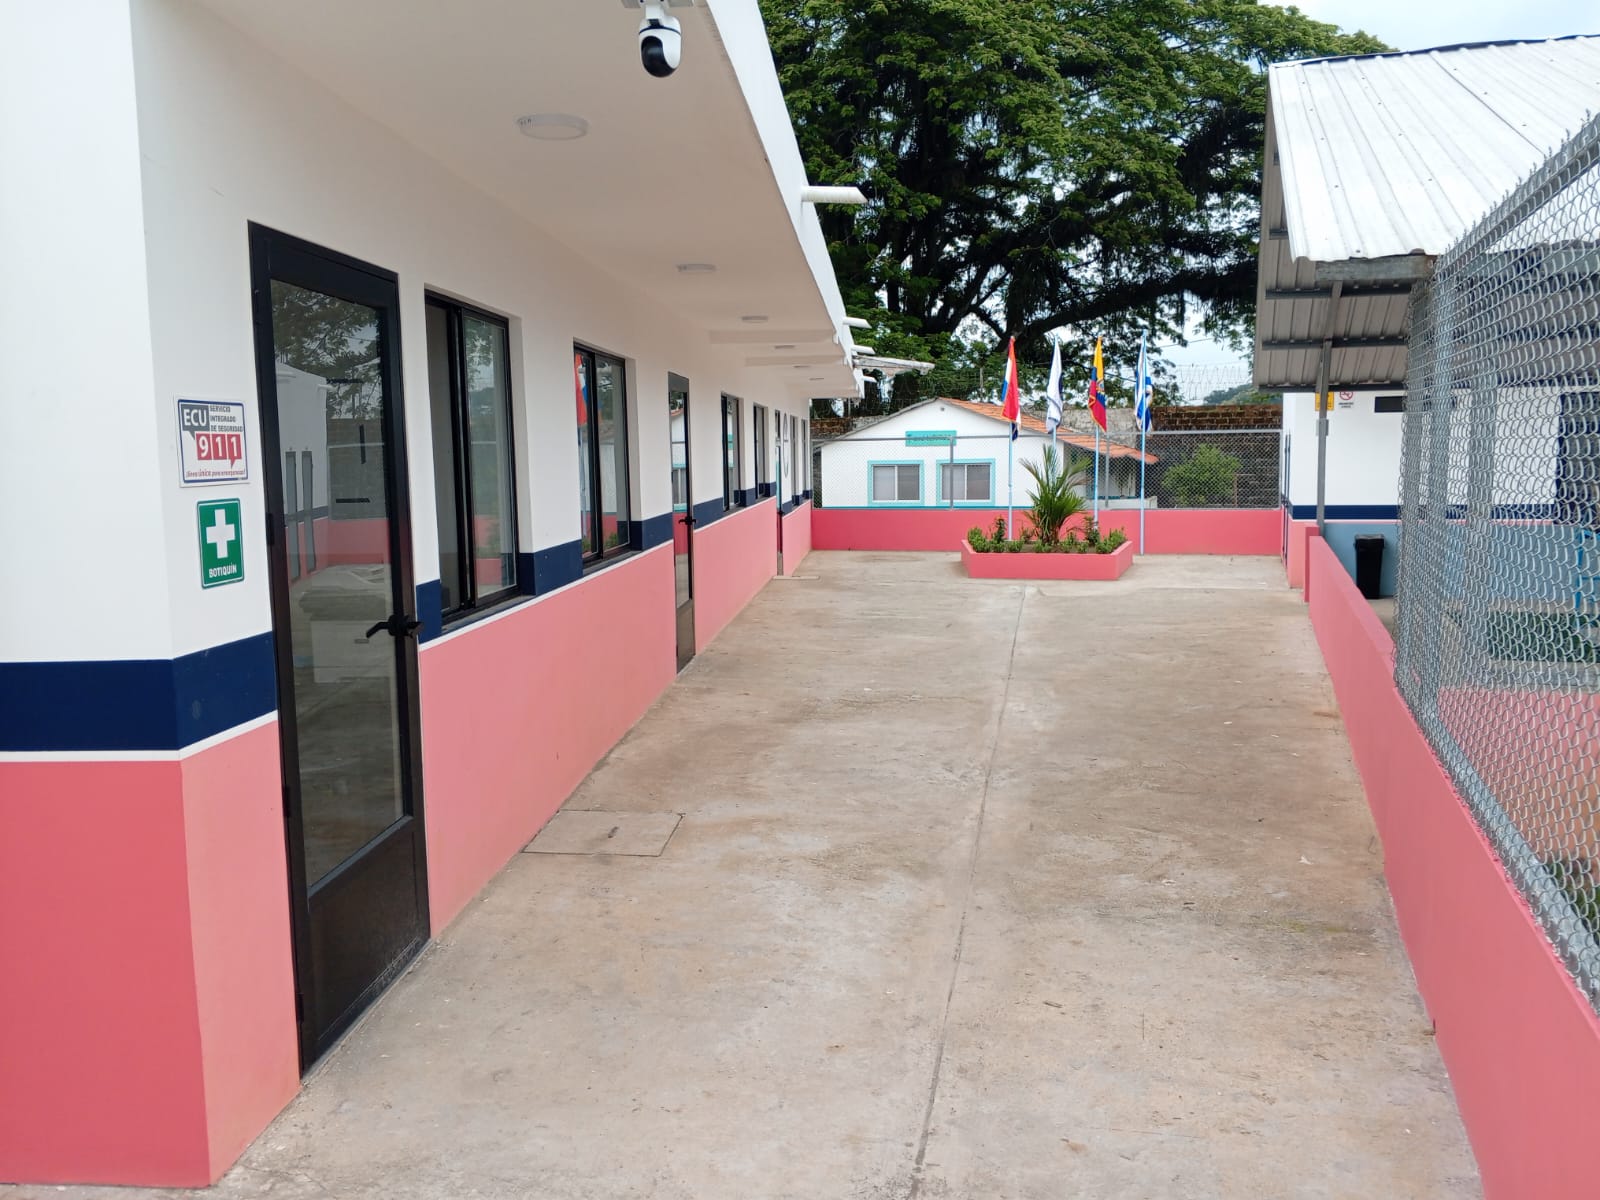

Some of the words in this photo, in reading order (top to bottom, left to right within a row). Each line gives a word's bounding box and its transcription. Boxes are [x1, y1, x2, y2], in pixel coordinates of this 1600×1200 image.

[210, 405, 231, 413] SERVICIO
[184, 409, 207, 426] ECU
[210, 415, 236, 423] INTEGRADO
[210, 424, 217, 432] DE
[199, 436, 238, 458] 911
[209, 562, 237, 578] BOTIQUÍN
